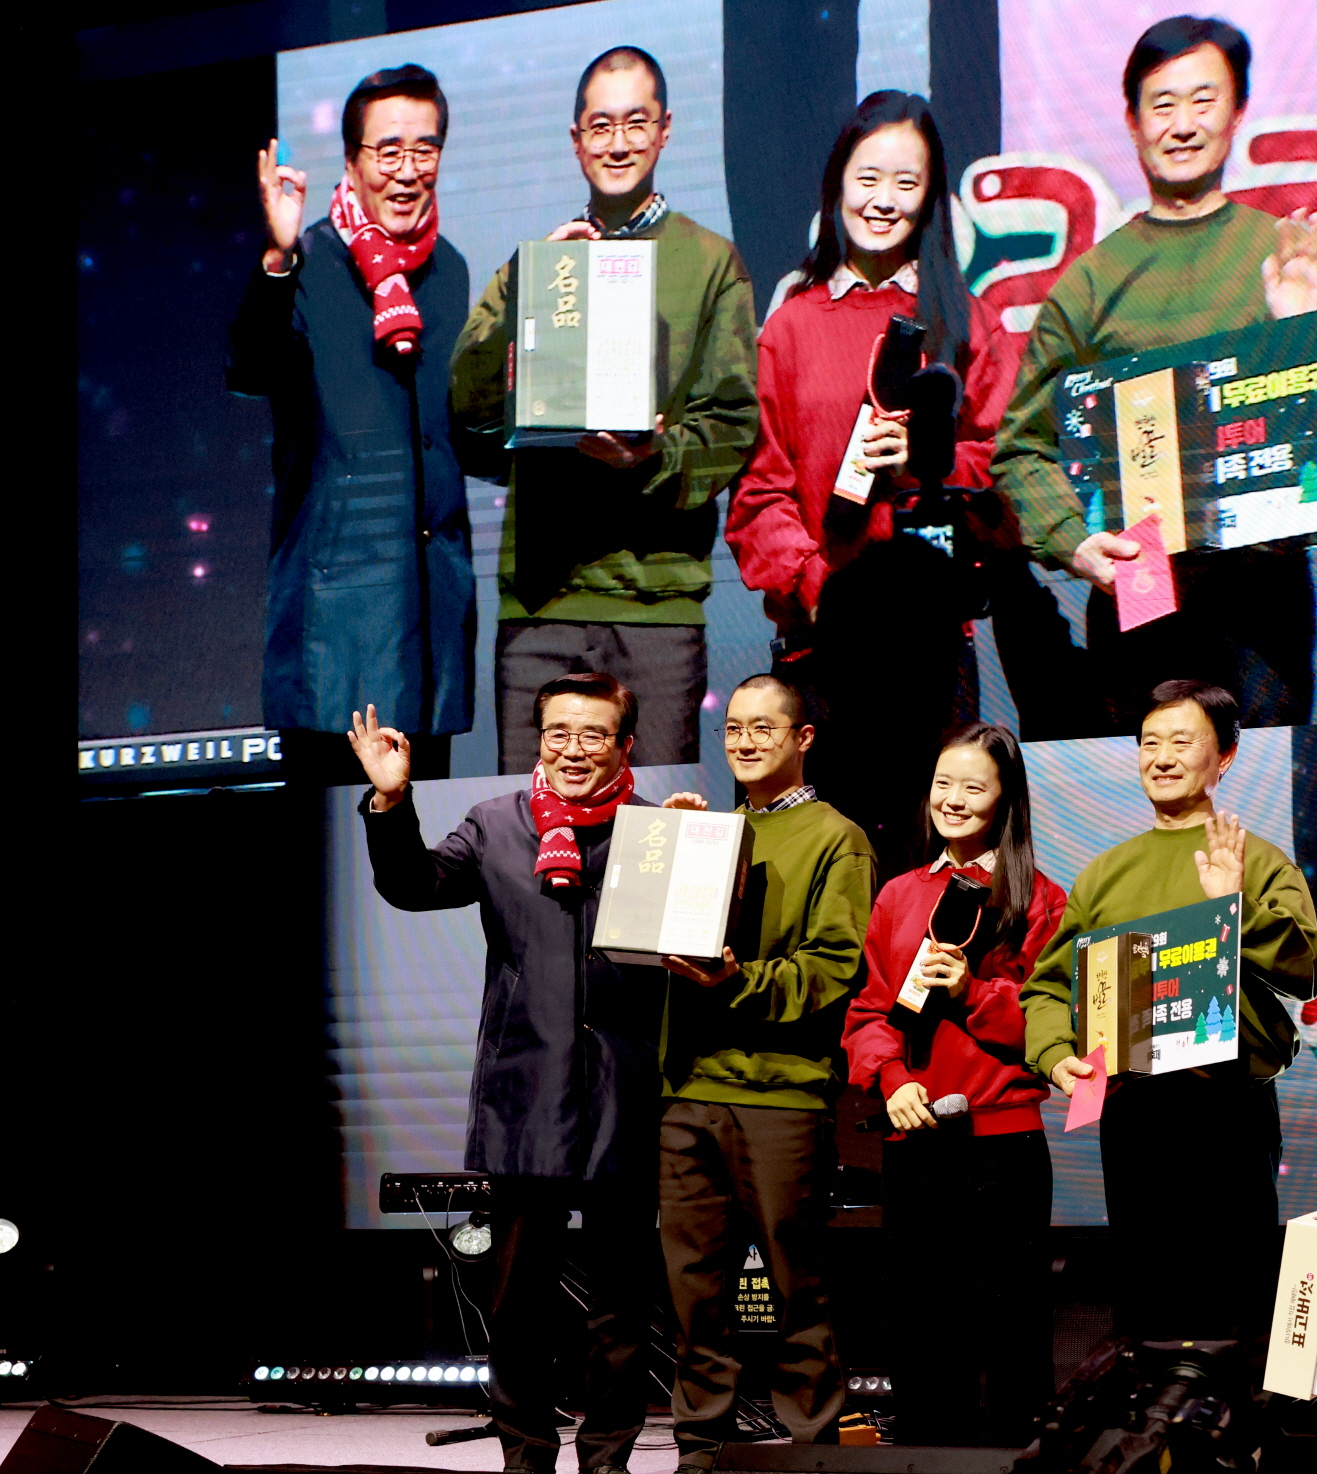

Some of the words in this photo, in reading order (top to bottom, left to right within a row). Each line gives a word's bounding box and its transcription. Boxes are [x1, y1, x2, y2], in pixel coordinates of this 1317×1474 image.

[547, 254, 582, 328] 名品
[1216, 416, 1267, 451] 투어
[1249, 443, 1295, 477] 전용
[78, 739, 233, 769] KURZWEIL
[638, 818, 668, 874] 名品
[690, 825, 725, 837] 대천김
[1159, 937, 1218, 969] 무료이용권
[1152, 977, 1180, 1002] 투어
[1170, 998, 1193, 1022] 전용
[737, 1293, 750, 1301] 손상
[1292, 1280, 1313, 1348] 표고버섯
